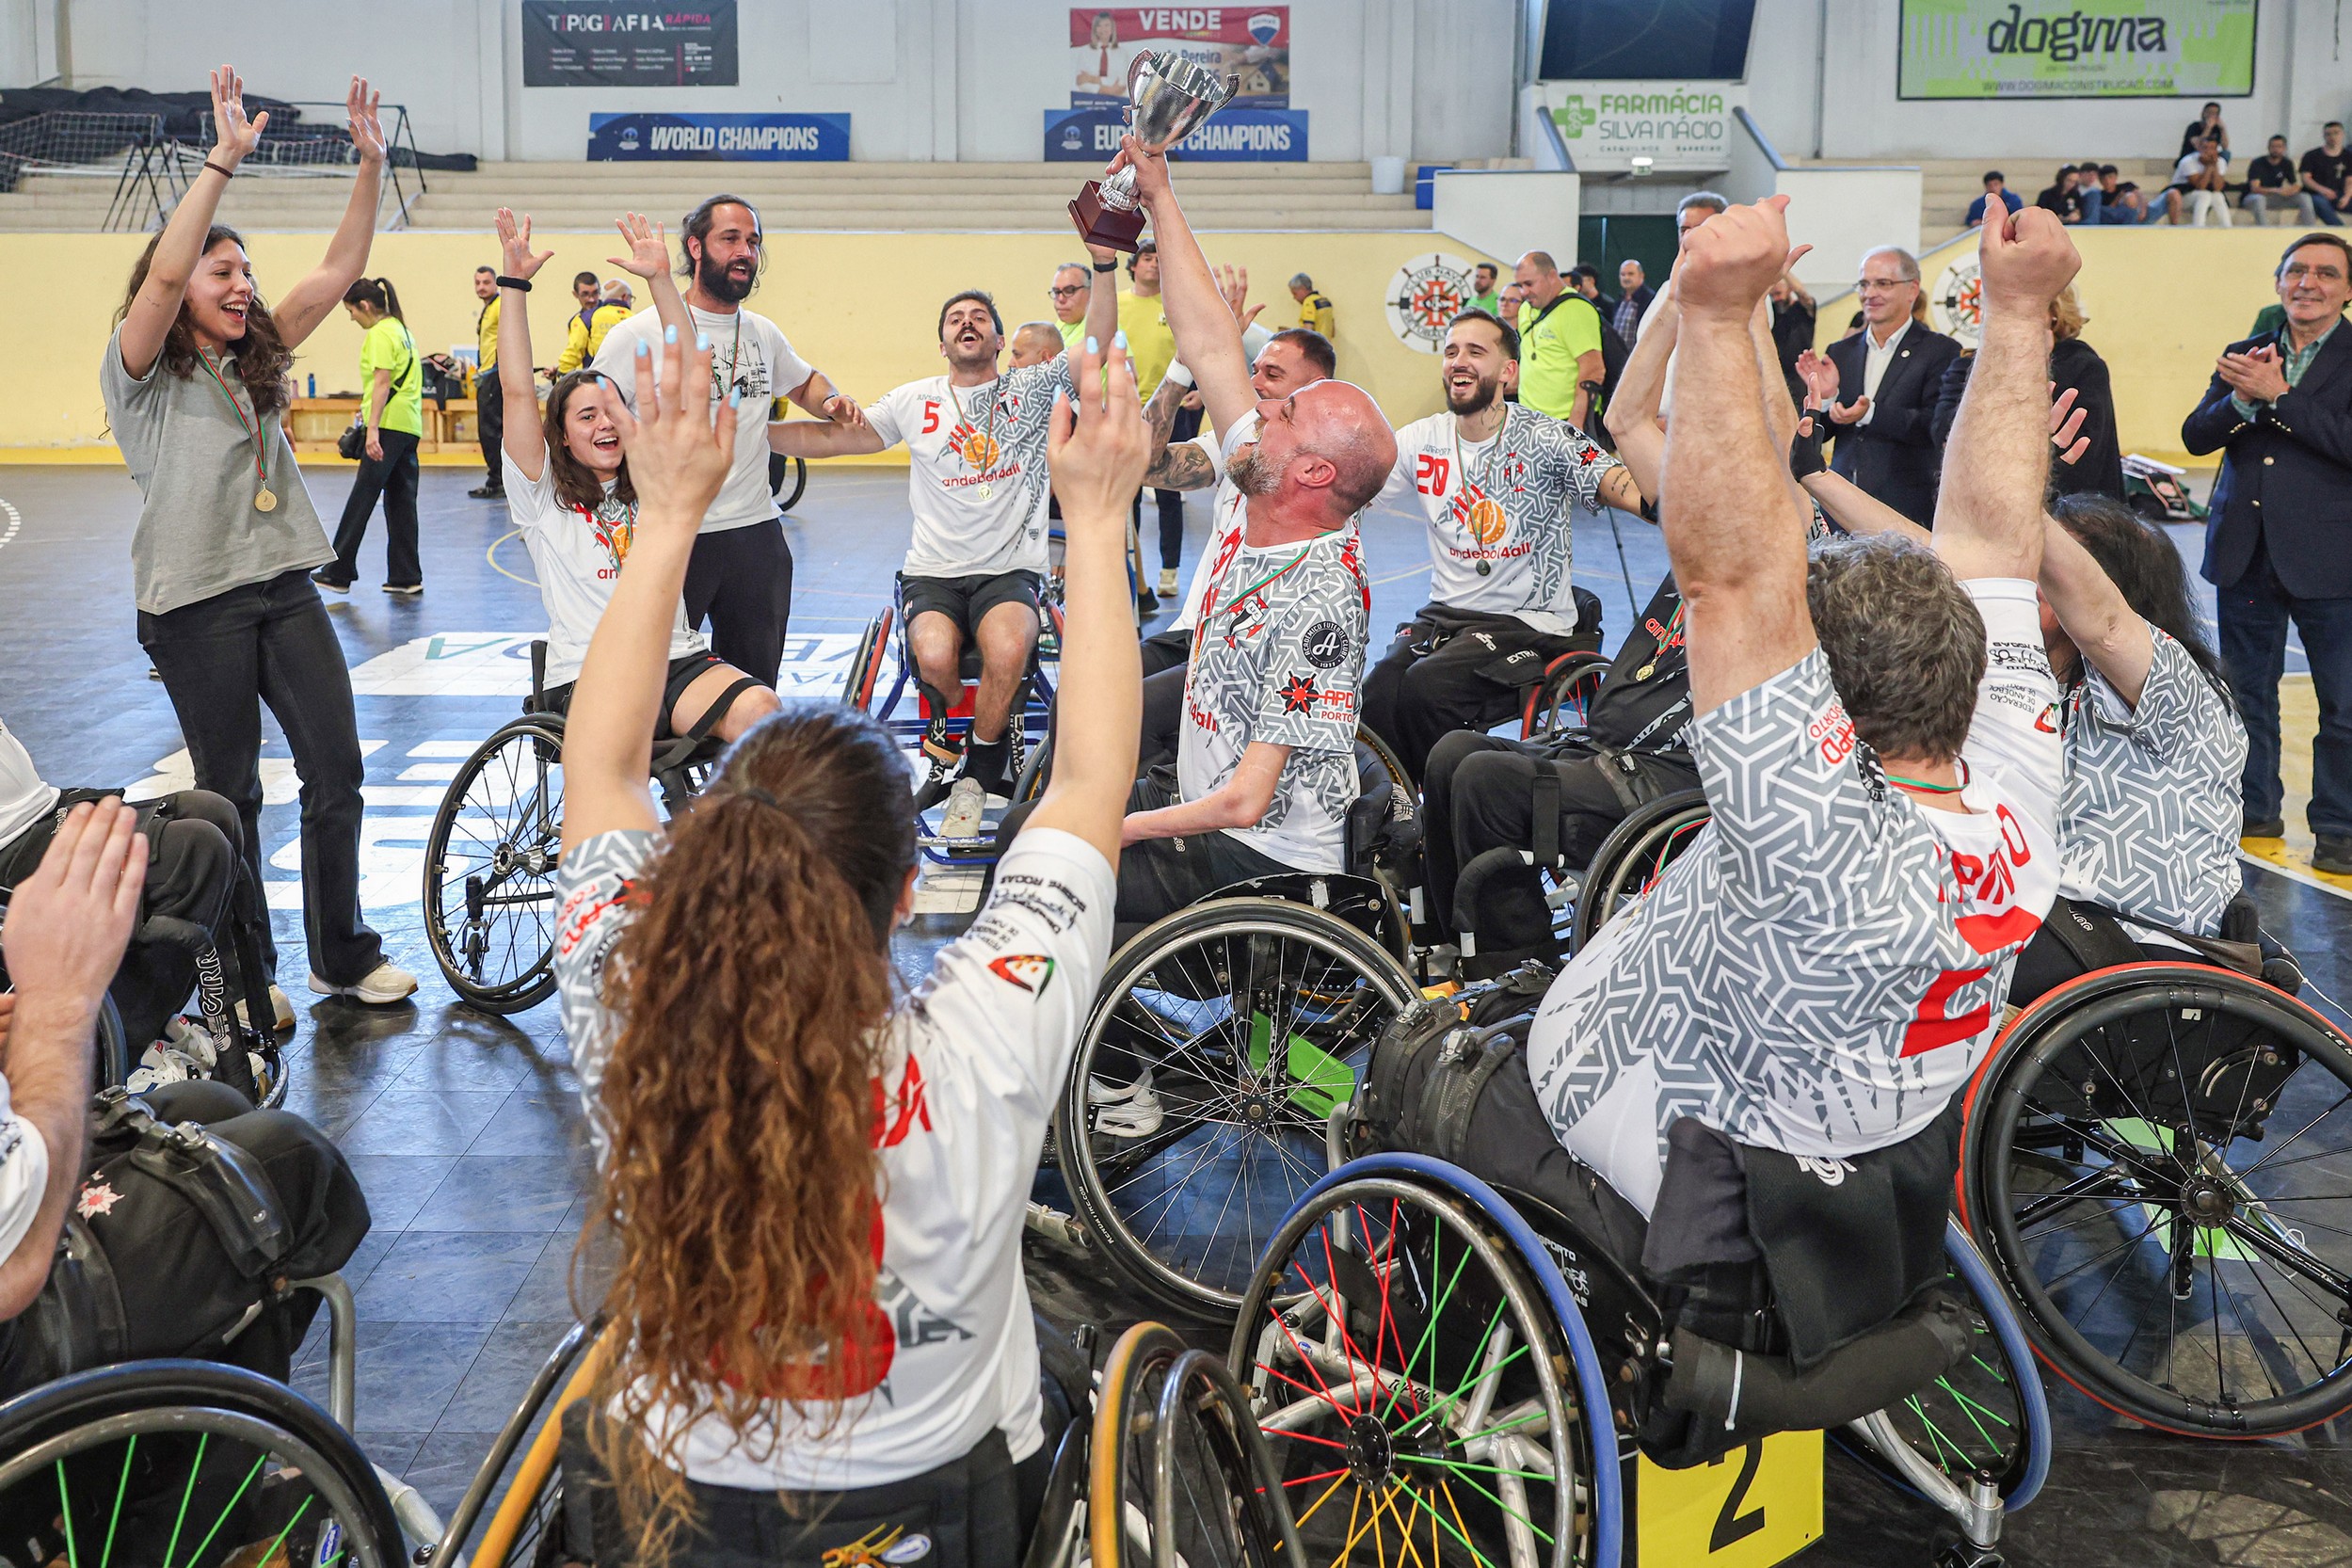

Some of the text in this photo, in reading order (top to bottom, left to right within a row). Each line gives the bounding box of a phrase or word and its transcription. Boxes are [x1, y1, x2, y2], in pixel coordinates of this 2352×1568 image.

[1138, 8, 1222, 31] VENDE
[1987, 4, 2167, 61] dogma
[1181, 48, 1222, 64] Pereira
[1600, 88, 1723, 115] FARMÁCIA
[650, 126, 819, 152] WORLD CHAMPIONS
[1188, 124, 1291, 152] CHAMPIONS
[1600, 116, 1723, 140] SILVA INÁCIO
[921, 400, 941, 434] 5
[1416, 454, 1449, 496] 20
[1323, 689, 1354, 709] APD
[1990, 693, 2035, 714] FEDERAÇÃO
[1320, 711, 1353, 723] PORTO
[1707, 1438, 1767, 1555] 2
